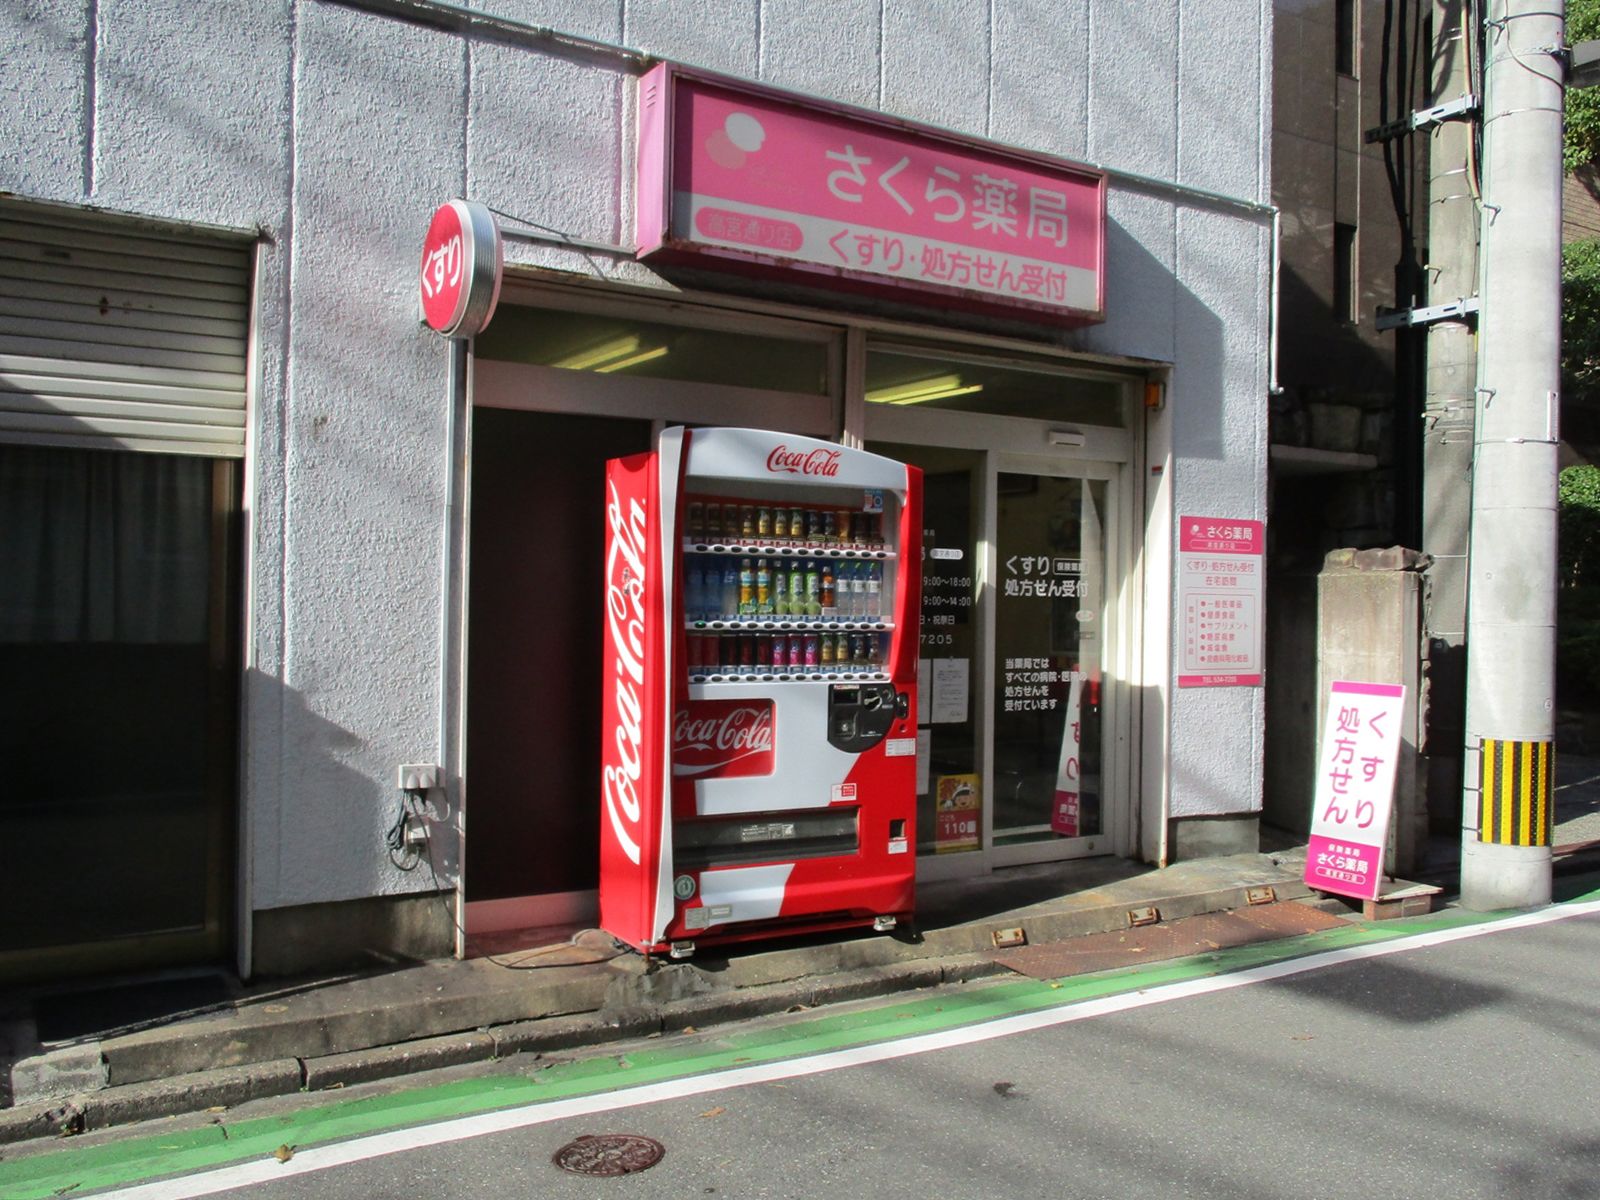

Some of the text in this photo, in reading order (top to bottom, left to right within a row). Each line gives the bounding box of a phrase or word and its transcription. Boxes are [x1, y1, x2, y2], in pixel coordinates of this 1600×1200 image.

[825, 144, 1069, 249] さくら薬局
[422, 234, 461, 298] くすり
[828, 229, 1067, 301] くすり・処方せん受付
[766, 445, 842, 477] Coca-Cola
[1207, 526, 1253, 541] さくら薬局
[1006, 555, 1050, 575] くすり
[1005, 578, 1089, 597] 処方せん受付
[1005, 657, 1050, 669] 当薬局では
[1005, 685, 1050, 697] 処方せんを
[1004, 698, 1058, 711] 受付ています
[1322, 706, 1360, 825] 処方せん
[1354, 711, 1387, 828] くすり
[1317, 852, 1369, 875] さくら薬局
